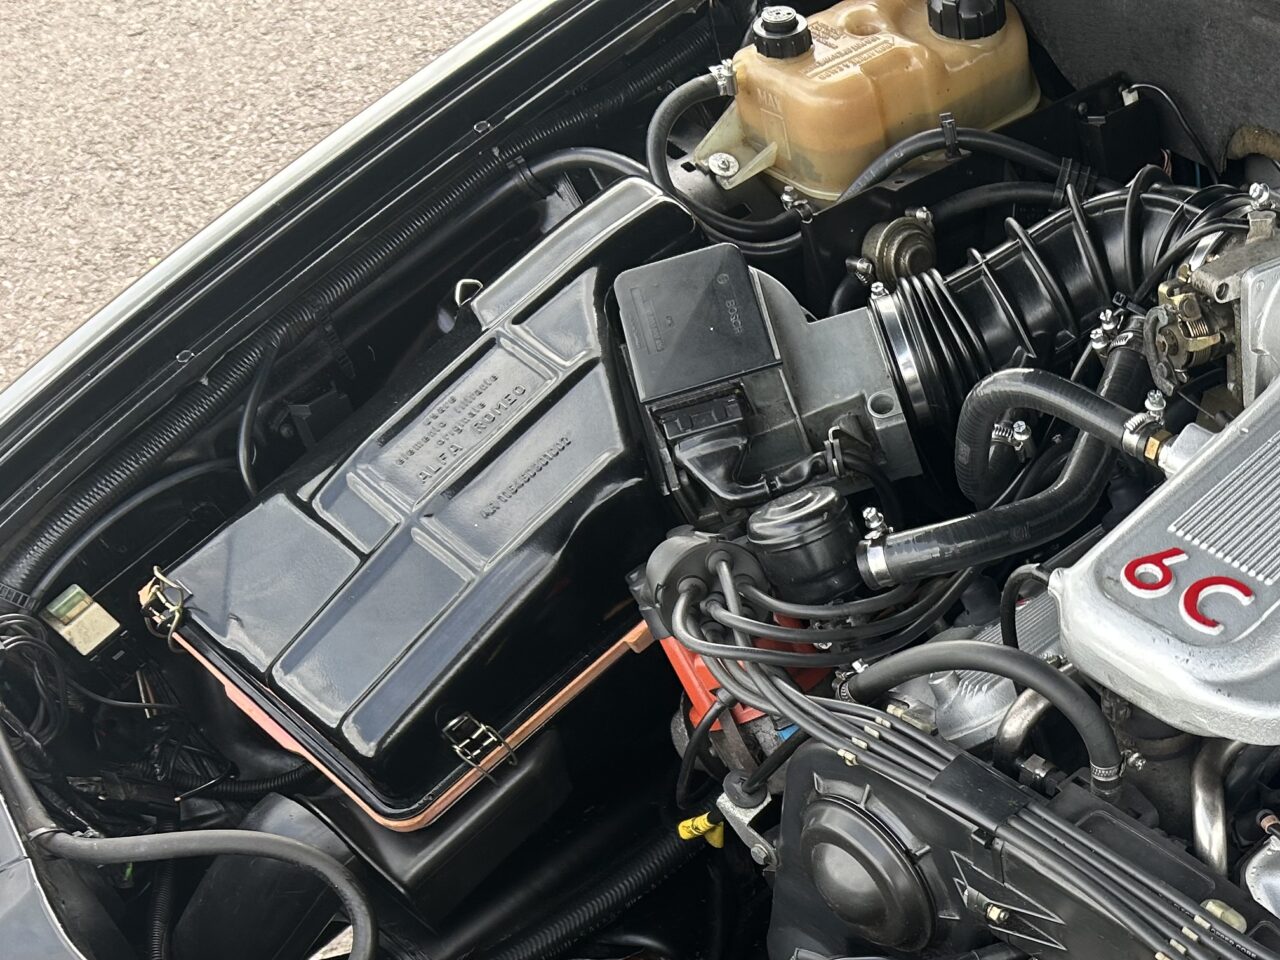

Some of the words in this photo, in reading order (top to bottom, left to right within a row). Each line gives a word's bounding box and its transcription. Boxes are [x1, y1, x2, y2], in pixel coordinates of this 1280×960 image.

[394, 418, 448, 466] elemento
[415, 440, 464, 484] ALFA
[470, 381, 529, 434] ROMEO
[434, 400, 489, 449] originale
[1120, 546, 1255, 634] 6C
